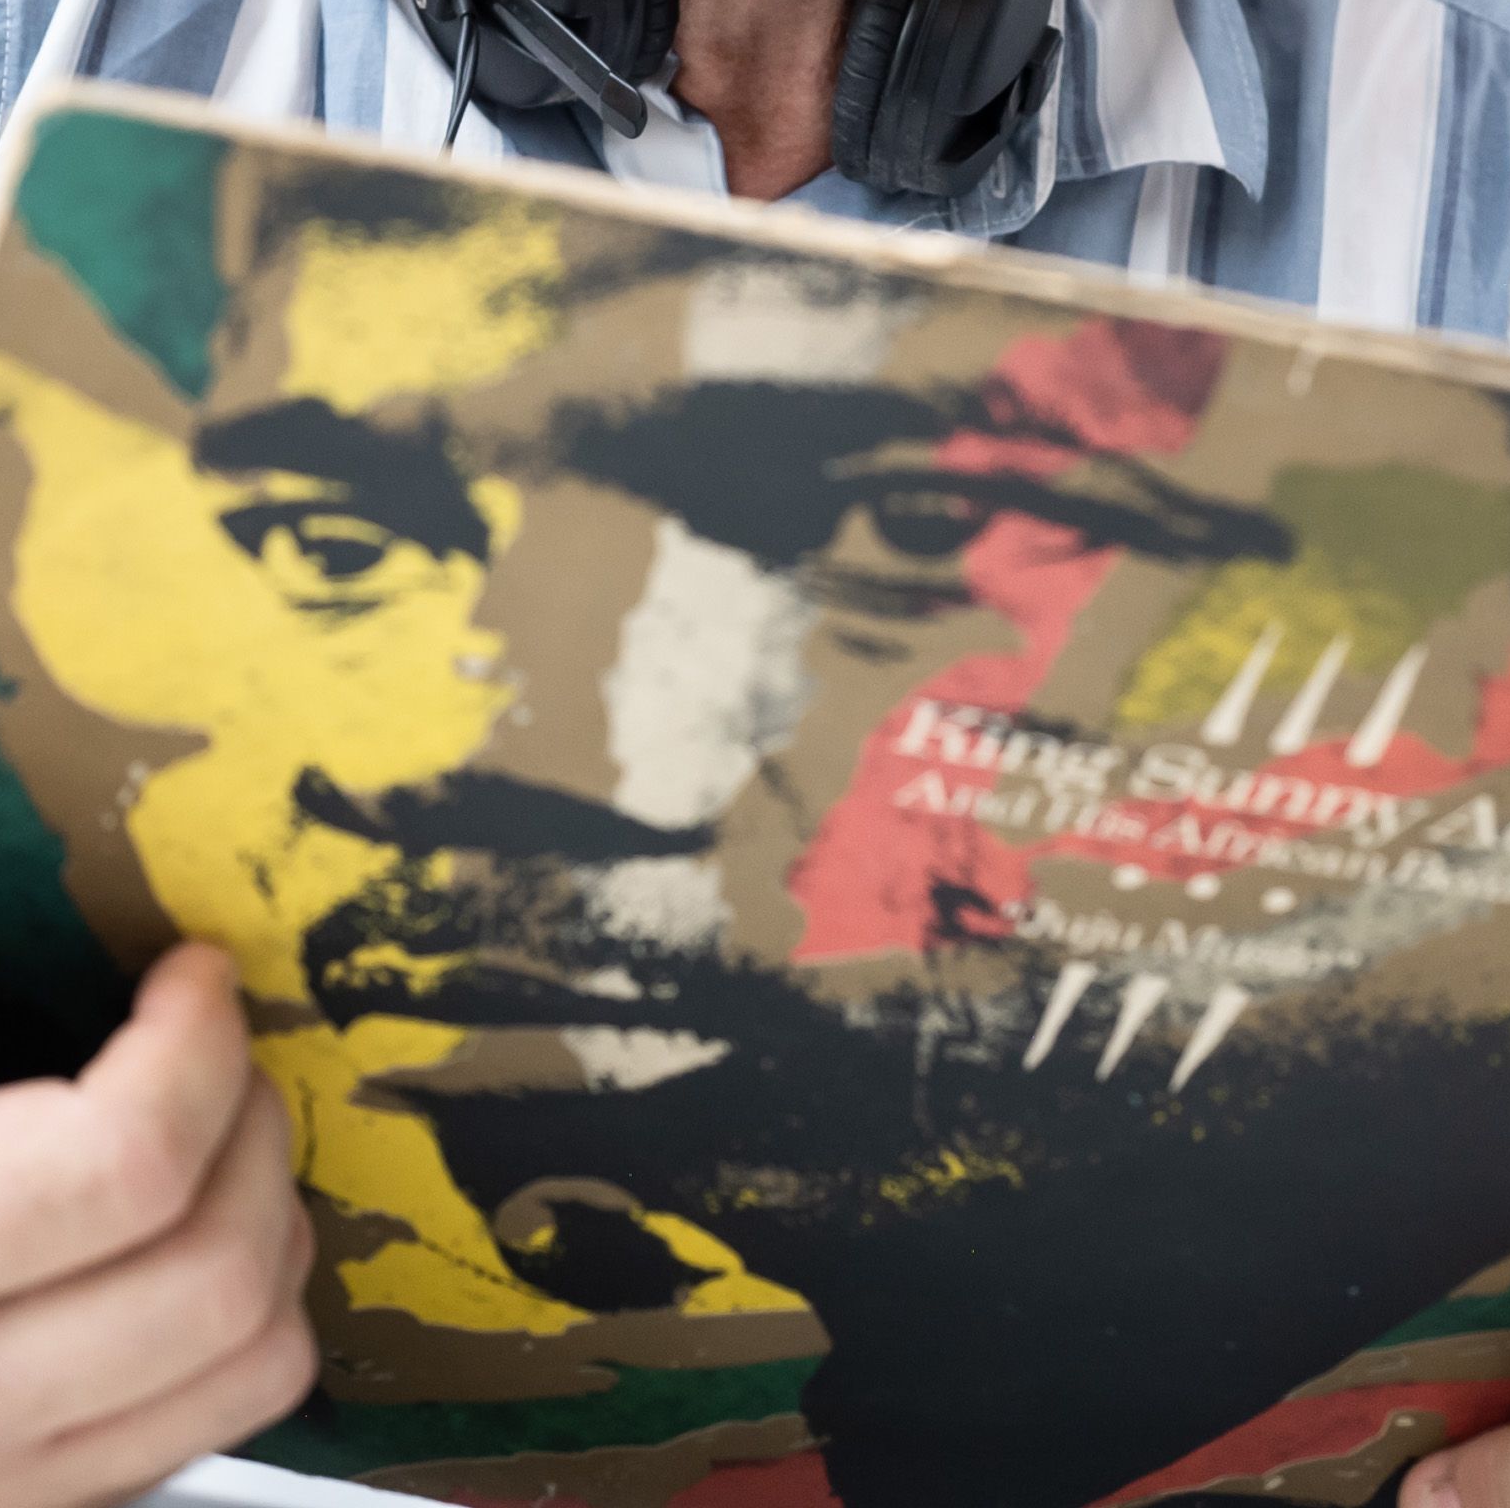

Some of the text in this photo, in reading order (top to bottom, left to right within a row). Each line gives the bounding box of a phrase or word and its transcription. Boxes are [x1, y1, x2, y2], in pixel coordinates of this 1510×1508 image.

[892, 769, 1038, 829] And
[1042, 792, 1148, 841] His
[1148, 812, 1389, 883] African
[893, 699, 1123, 798] King
[1128, 741, 1429, 848] Sunny
